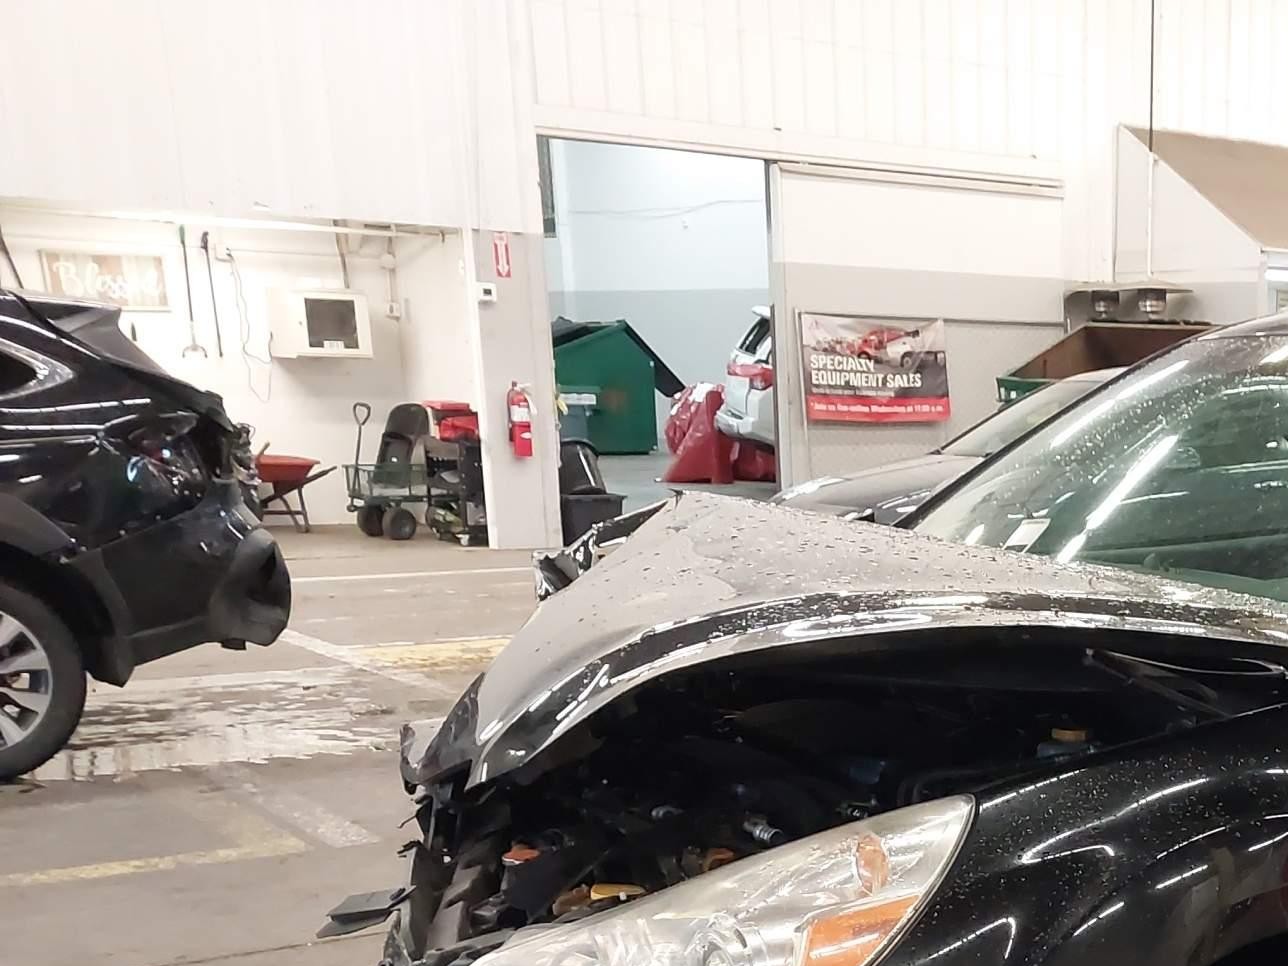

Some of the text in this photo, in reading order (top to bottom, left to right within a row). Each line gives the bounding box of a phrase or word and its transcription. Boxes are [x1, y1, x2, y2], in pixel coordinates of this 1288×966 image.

[810, 354, 874, 372] SPECIALTY
[811, 370, 922, 388] EQUIPMENT SALES
